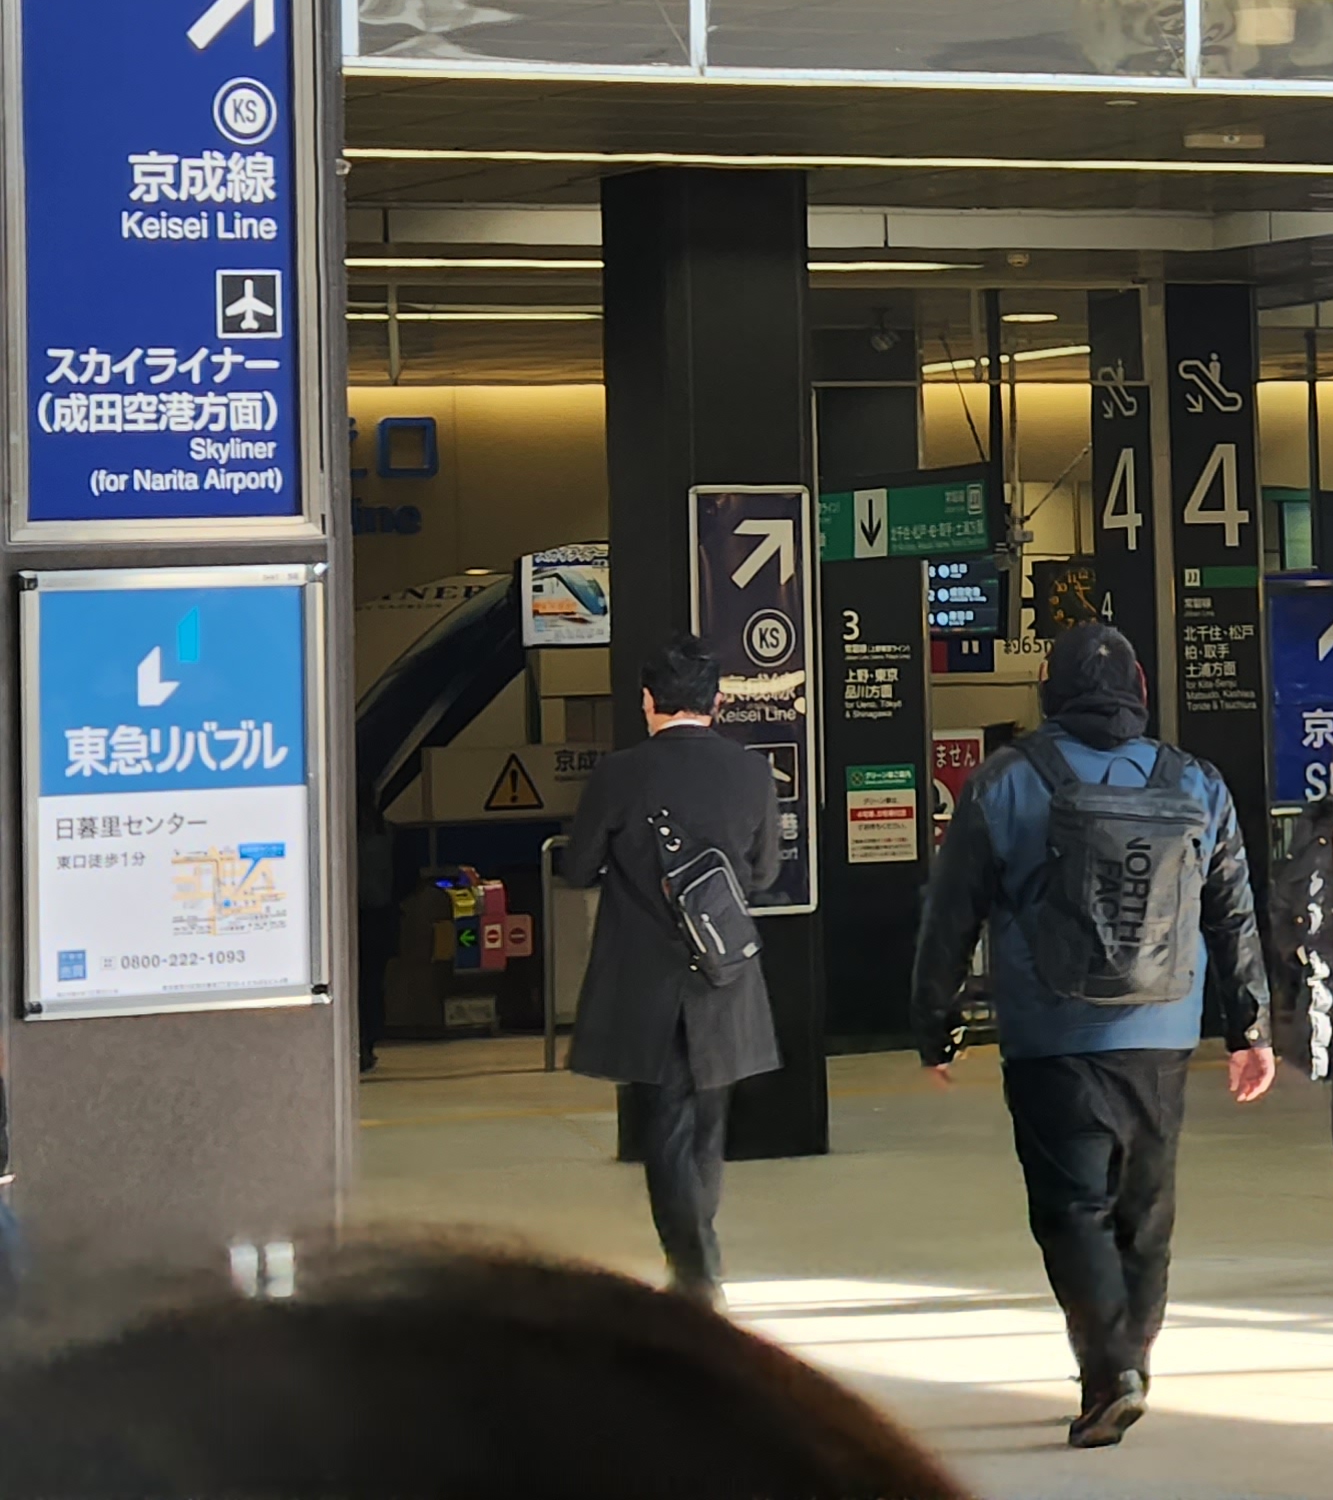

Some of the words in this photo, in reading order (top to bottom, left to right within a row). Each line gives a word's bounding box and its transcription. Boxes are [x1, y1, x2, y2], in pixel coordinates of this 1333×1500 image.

[232, 98, 258, 124] KS
[128, 151, 276, 203] 京成線
[121, 211, 209, 240] Keisei
[216, 211, 277, 240] Line
[45, 347, 281, 385] スカイライナー
[37, 391, 278, 434] (成田空港方面)
[189, 437, 276, 463] Skyliner
[90, 470, 129, 496] (for
[133, 469, 199, 491] Narita
[203, 467, 283, 494] Airport)
[1183, 443, 1250, 548] 4
[1103, 447, 1142, 551] 4
[352, 498, 423, 536] ine
[758, 627, 780, 649] KS
[842, 609, 861, 642] 3
[765, 707, 797, 722] Line
[64, 721, 289, 778] 東急リバブル
[56, 811, 208, 842] 日暮里センター
[56, 850, 147, 872] 東口徒歩1分
[120, 949, 247, 970] 0800-222-1093
